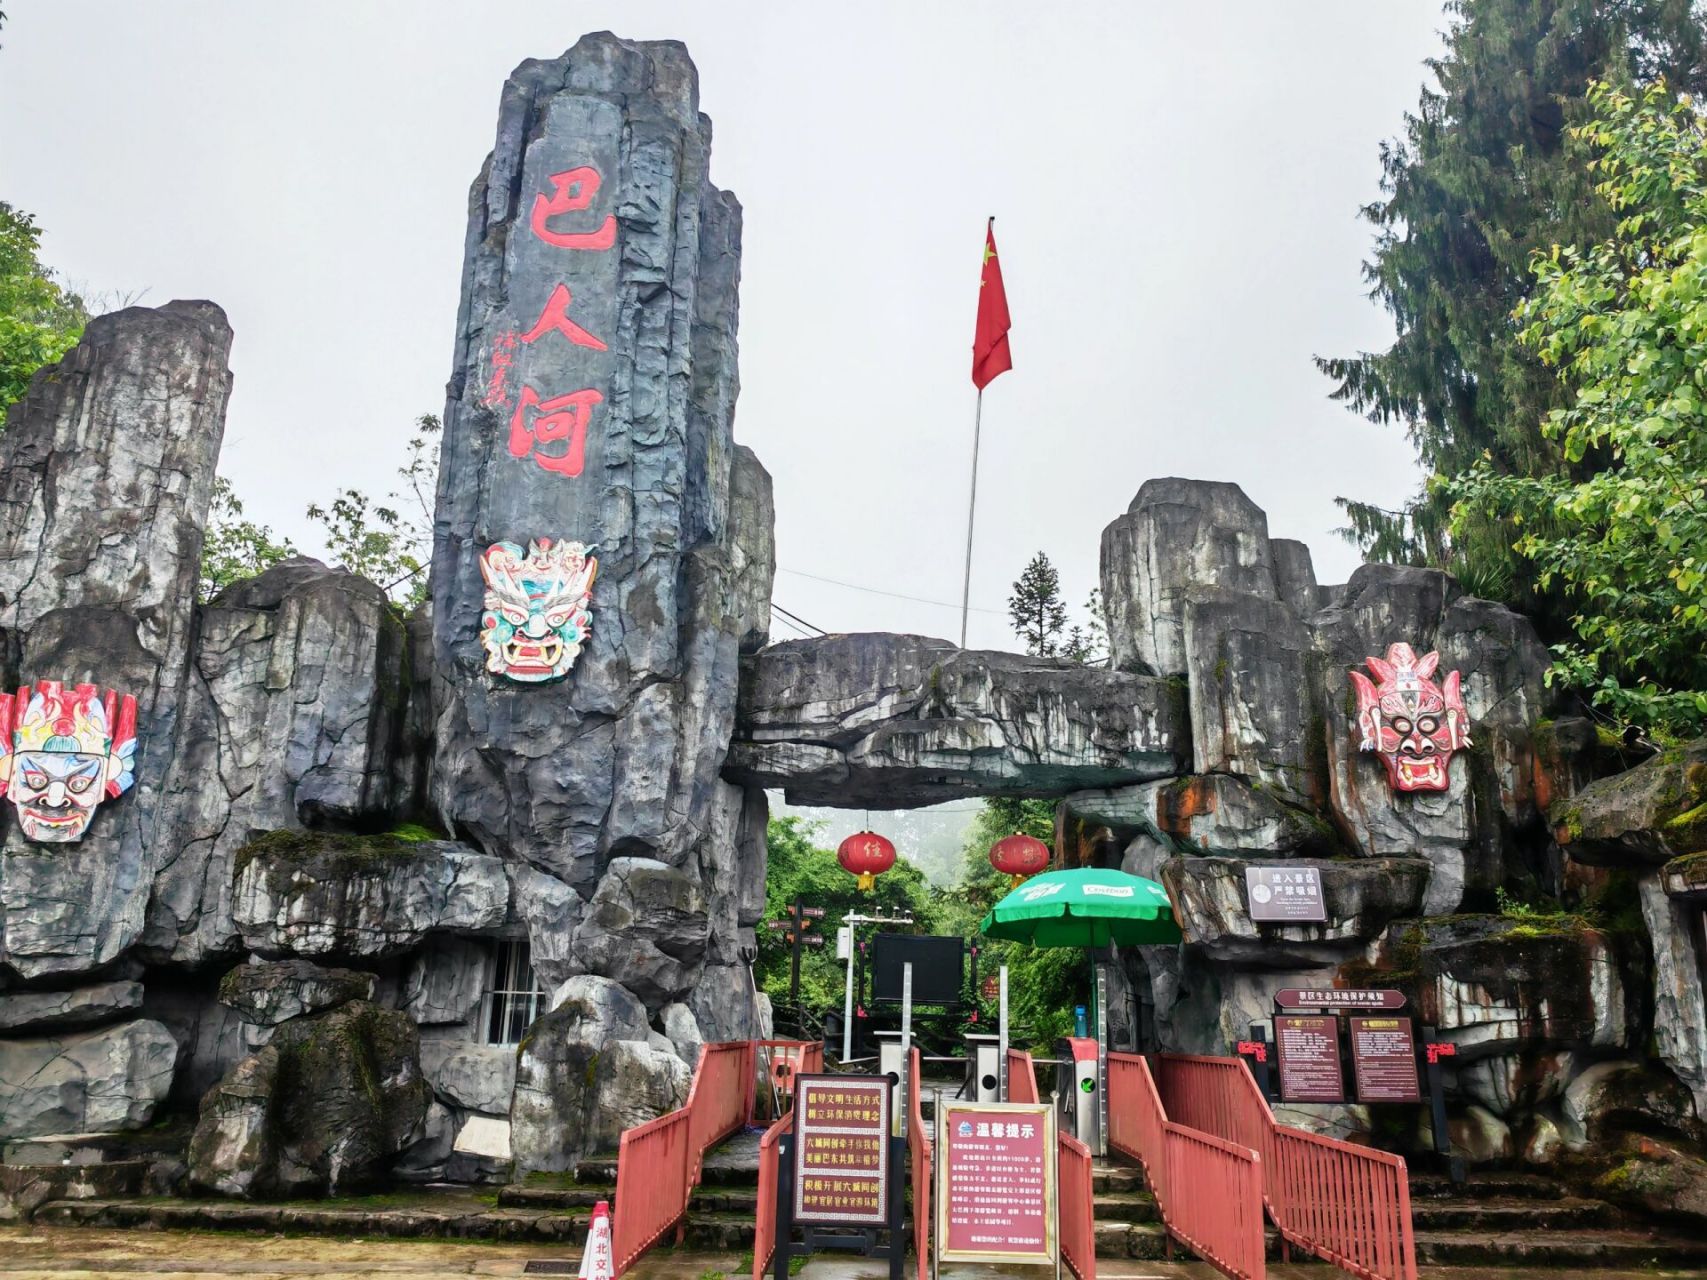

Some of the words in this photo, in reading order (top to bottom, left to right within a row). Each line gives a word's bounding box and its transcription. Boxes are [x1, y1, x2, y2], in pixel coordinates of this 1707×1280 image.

[508, 165, 617, 478] 巴人河
[1272, 873, 1315, 884] 进入景区
[1274, 885, 1317, 896] 严禁吸烟
[808, 1092, 880, 1106] 倡导文明生活方式
[808, 1107, 880, 1122] 树立环保消费理念
[976, 1122, 1034, 1139] 温馨提示
